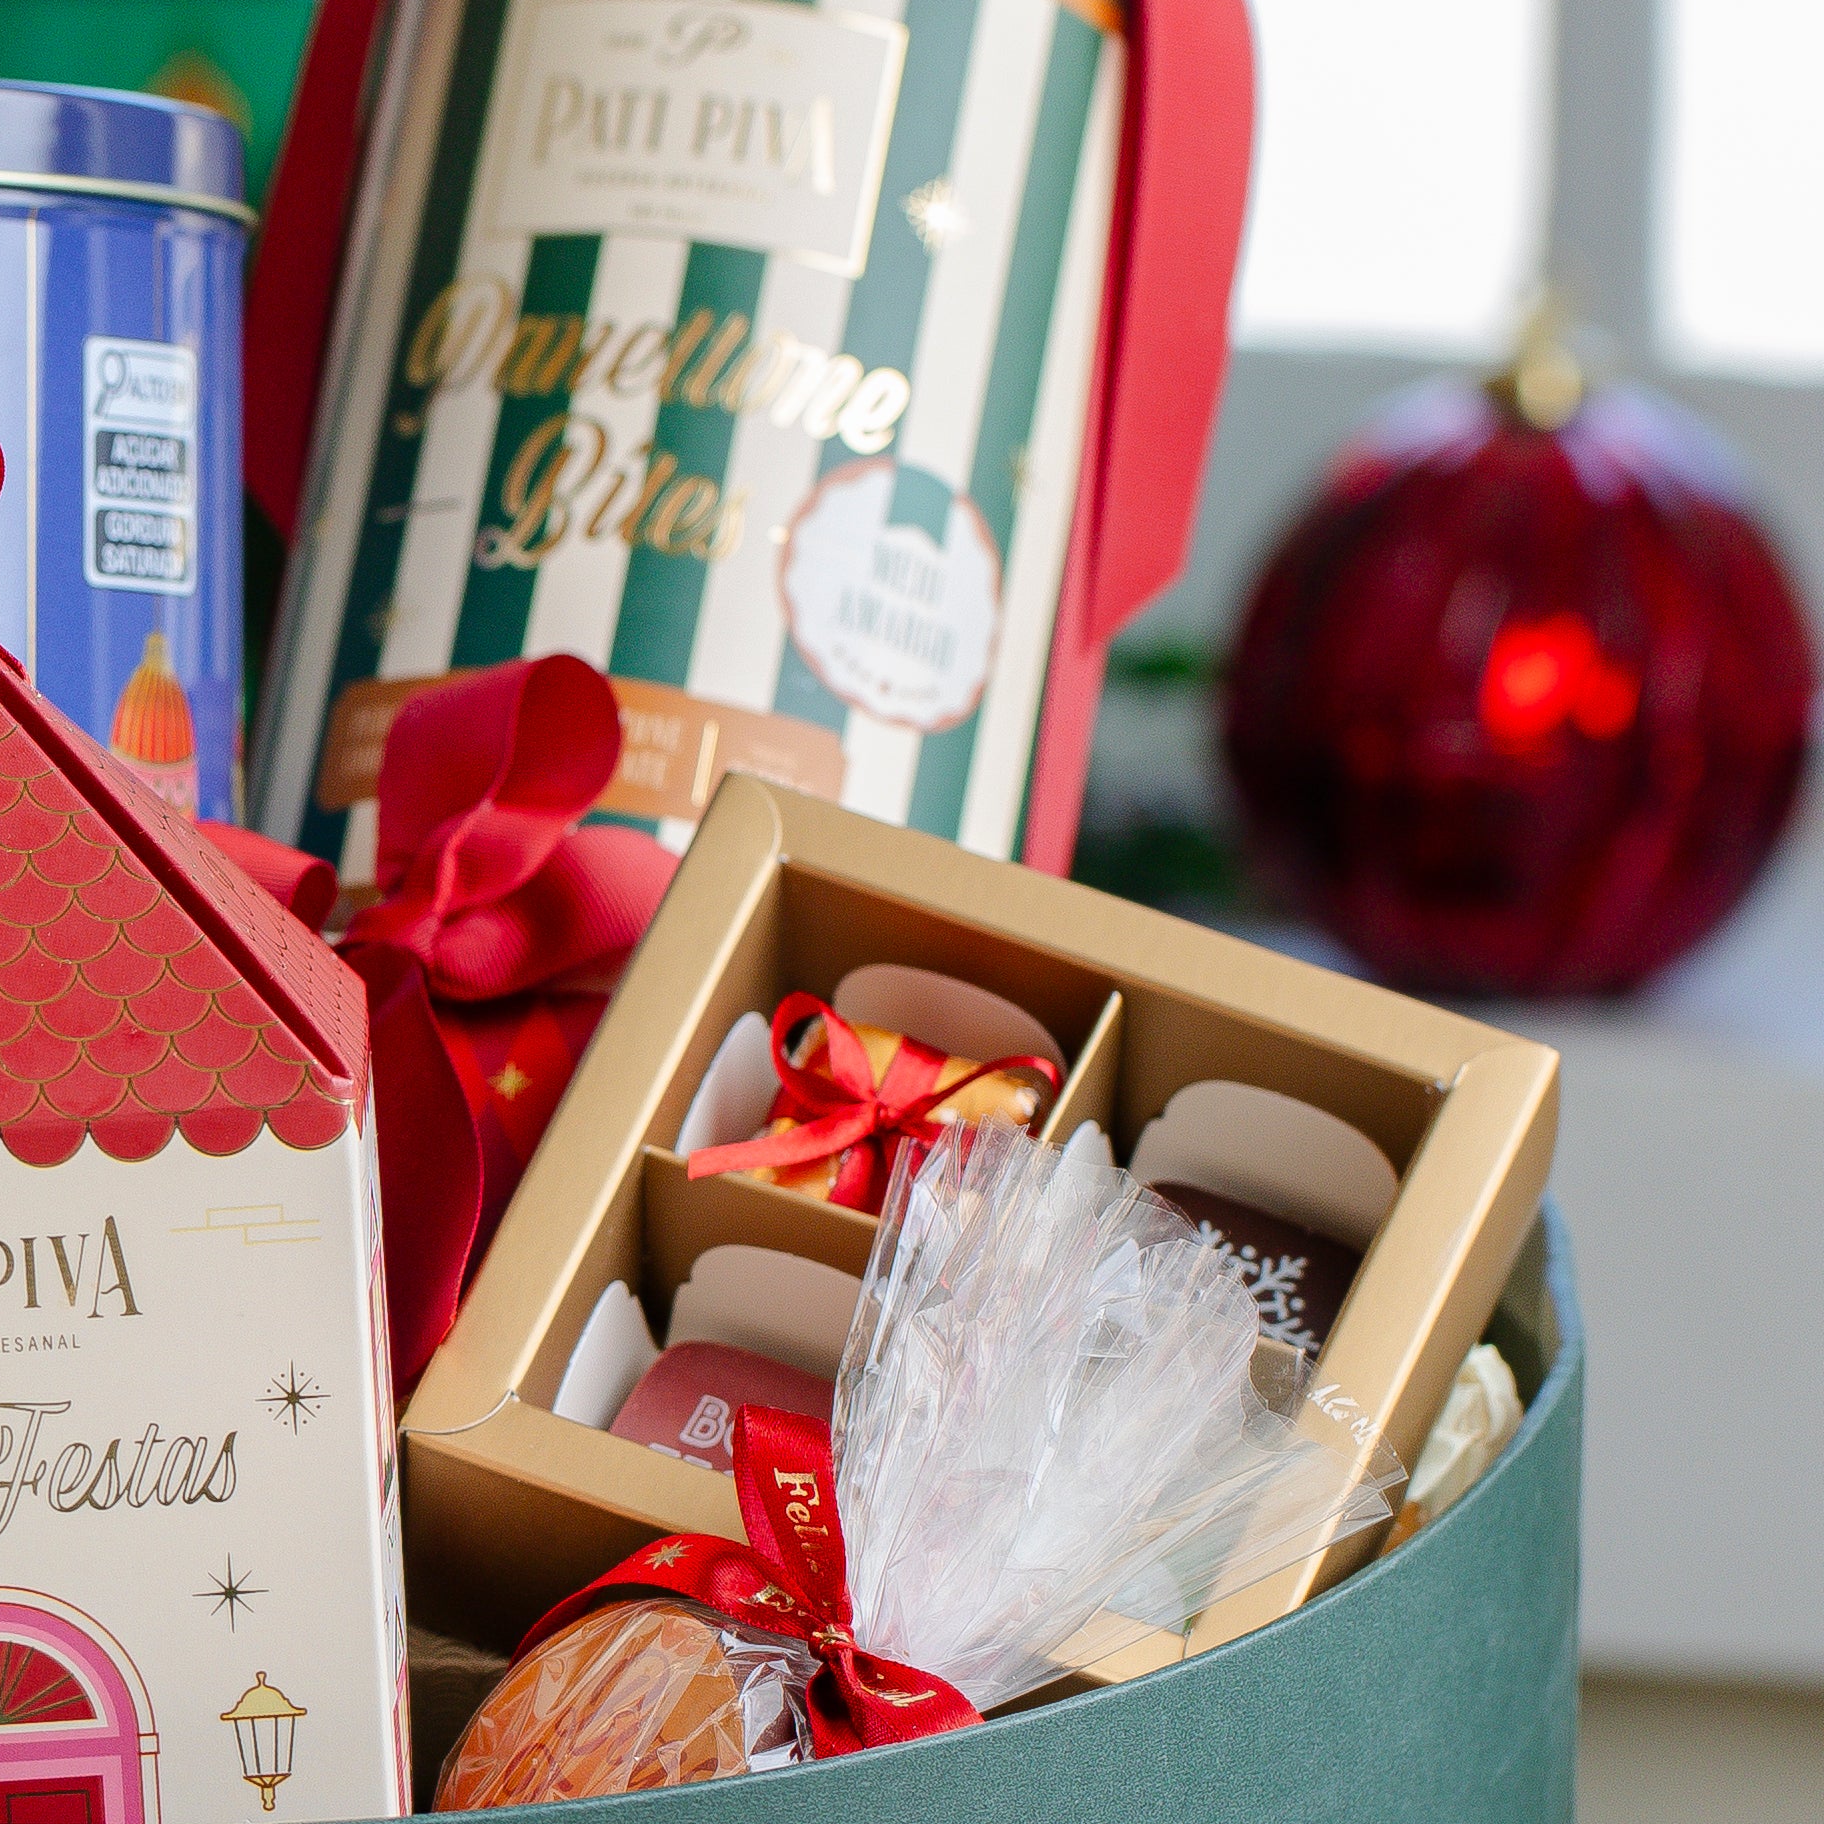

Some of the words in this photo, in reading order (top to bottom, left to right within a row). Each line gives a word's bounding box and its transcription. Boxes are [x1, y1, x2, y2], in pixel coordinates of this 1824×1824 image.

[529, 76, 669, 168] PATI
[689, 89, 838, 198] PIVA
[477, 412, 750, 572] Bites
